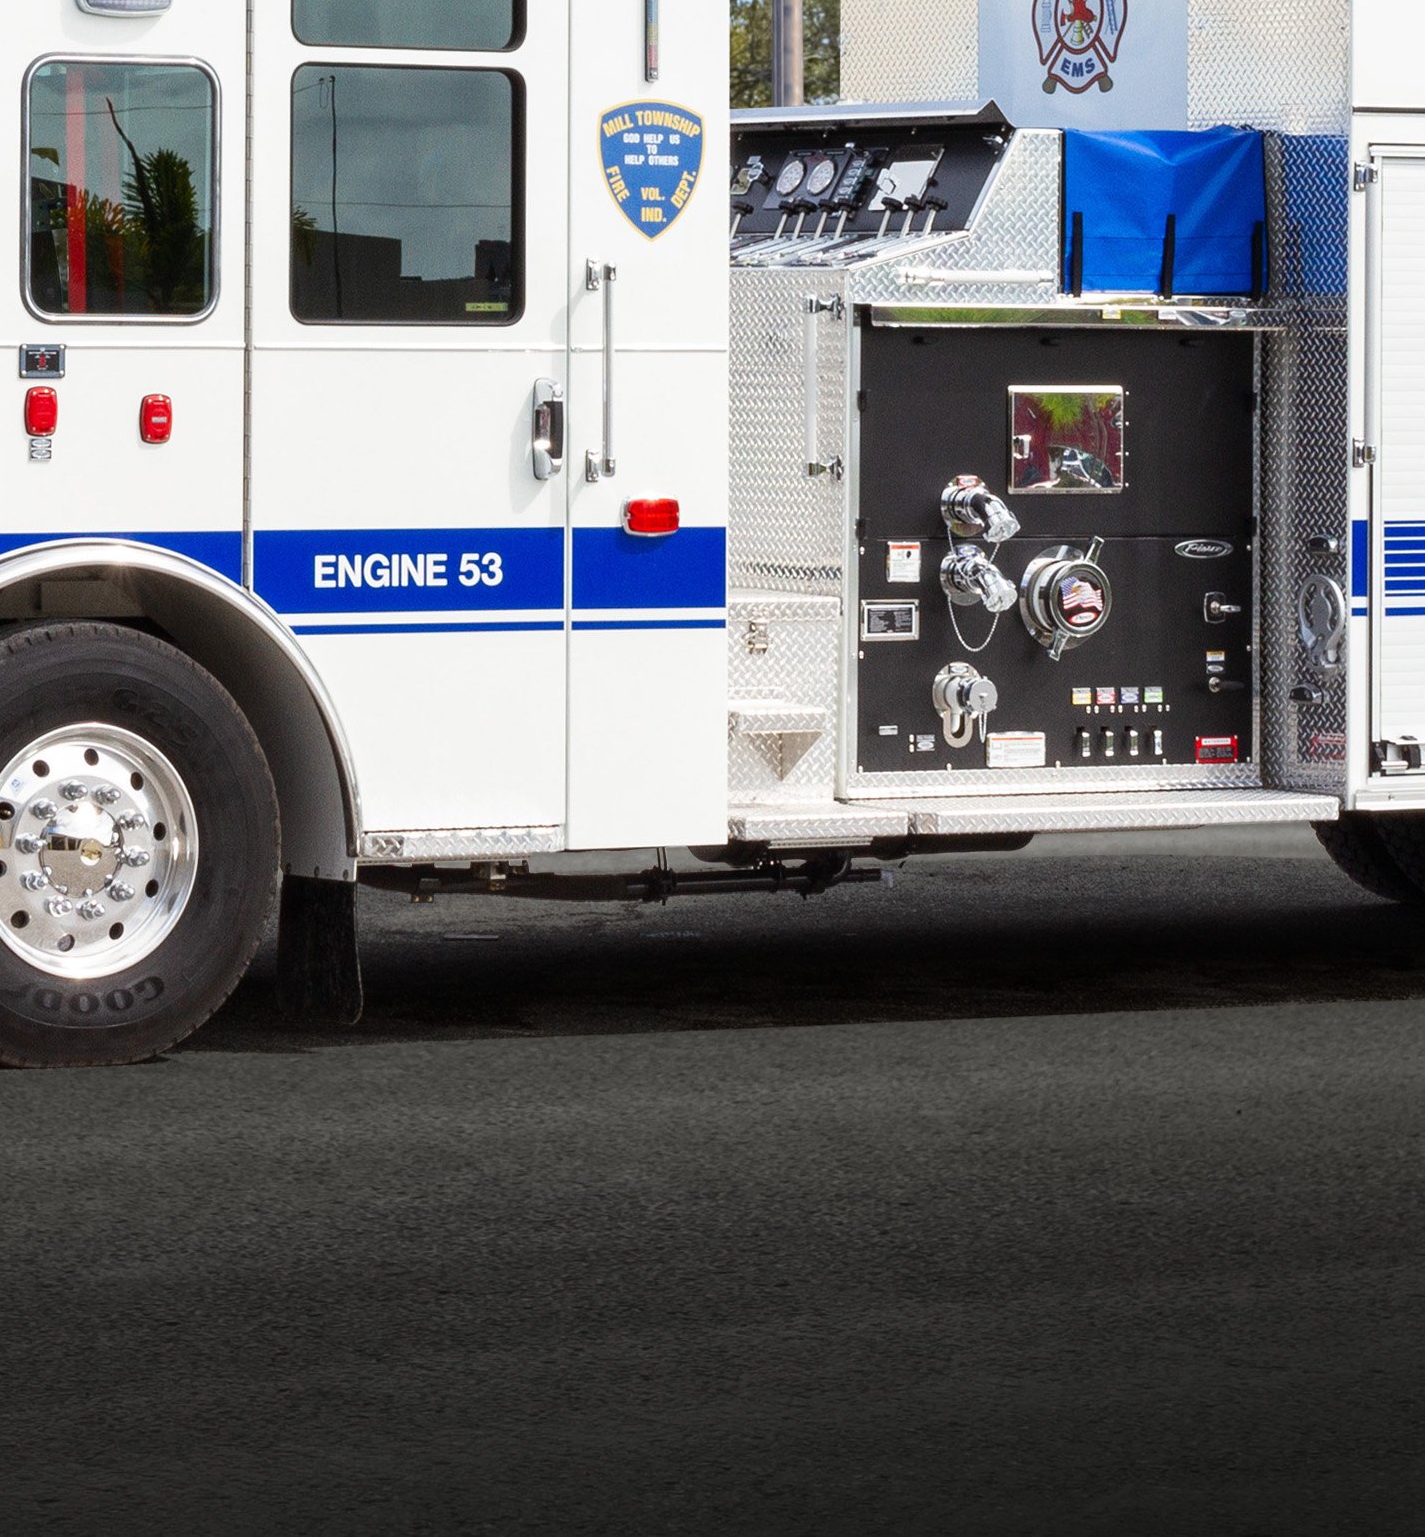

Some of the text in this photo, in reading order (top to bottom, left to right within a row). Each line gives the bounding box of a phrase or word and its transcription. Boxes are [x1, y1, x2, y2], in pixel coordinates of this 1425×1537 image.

[1060, 57, 1096, 78] EMS
[602, 109, 701, 138] MILL TOWNSHIP
[623, 133, 681, 145] GOD HELP US
[646, 144, 658, 155] TO
[624, 154, 679, 166] HELP OTHERS
[606, 165, 631, 204] FIRE
[670, 170, 697, 209] DEPT.
[640, 187, 666, 202] VOL.
[640, 207, 668, 223] IND.
[314, 552, 504, 588] ENGINE 53
